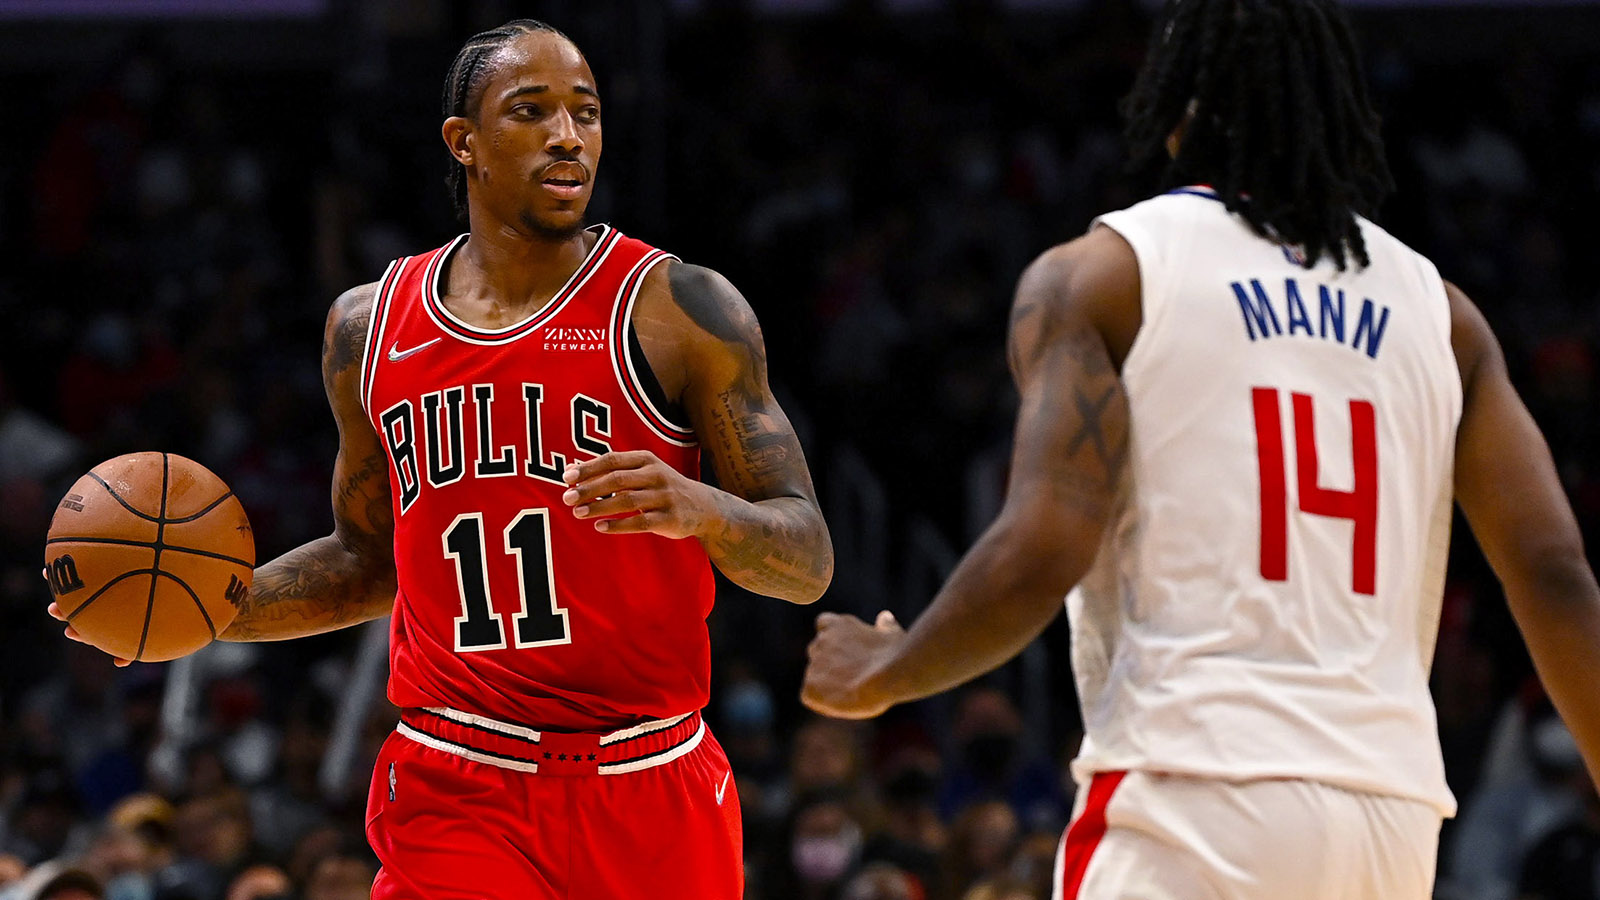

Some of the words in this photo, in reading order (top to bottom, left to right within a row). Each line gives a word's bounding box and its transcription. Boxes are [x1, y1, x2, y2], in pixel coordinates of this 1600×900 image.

[543, 343, 604, 351] EYEWEAR
[545, 328, 606, 341] ZENNI
[1230, 278, 1390, 359] MANN
[1251, 386, 1378, 596] 14
[441, 507, 572, 653] 11
